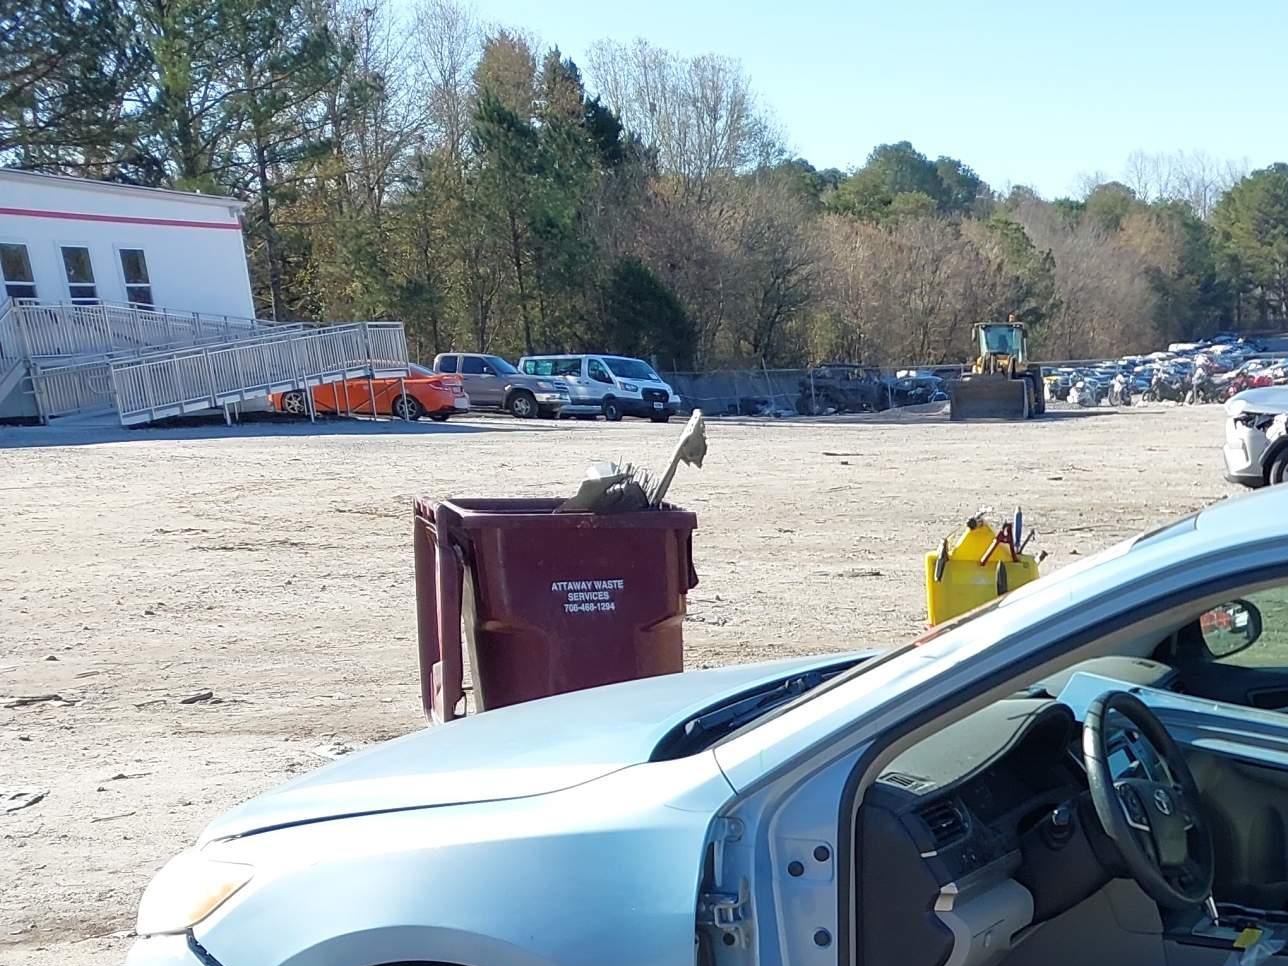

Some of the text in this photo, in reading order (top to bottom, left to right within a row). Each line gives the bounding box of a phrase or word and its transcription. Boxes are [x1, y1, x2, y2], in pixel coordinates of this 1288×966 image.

[551, 579, 625, 592] ATTAWAY WASTE
[567, 591, 610, 602] SERVICES
